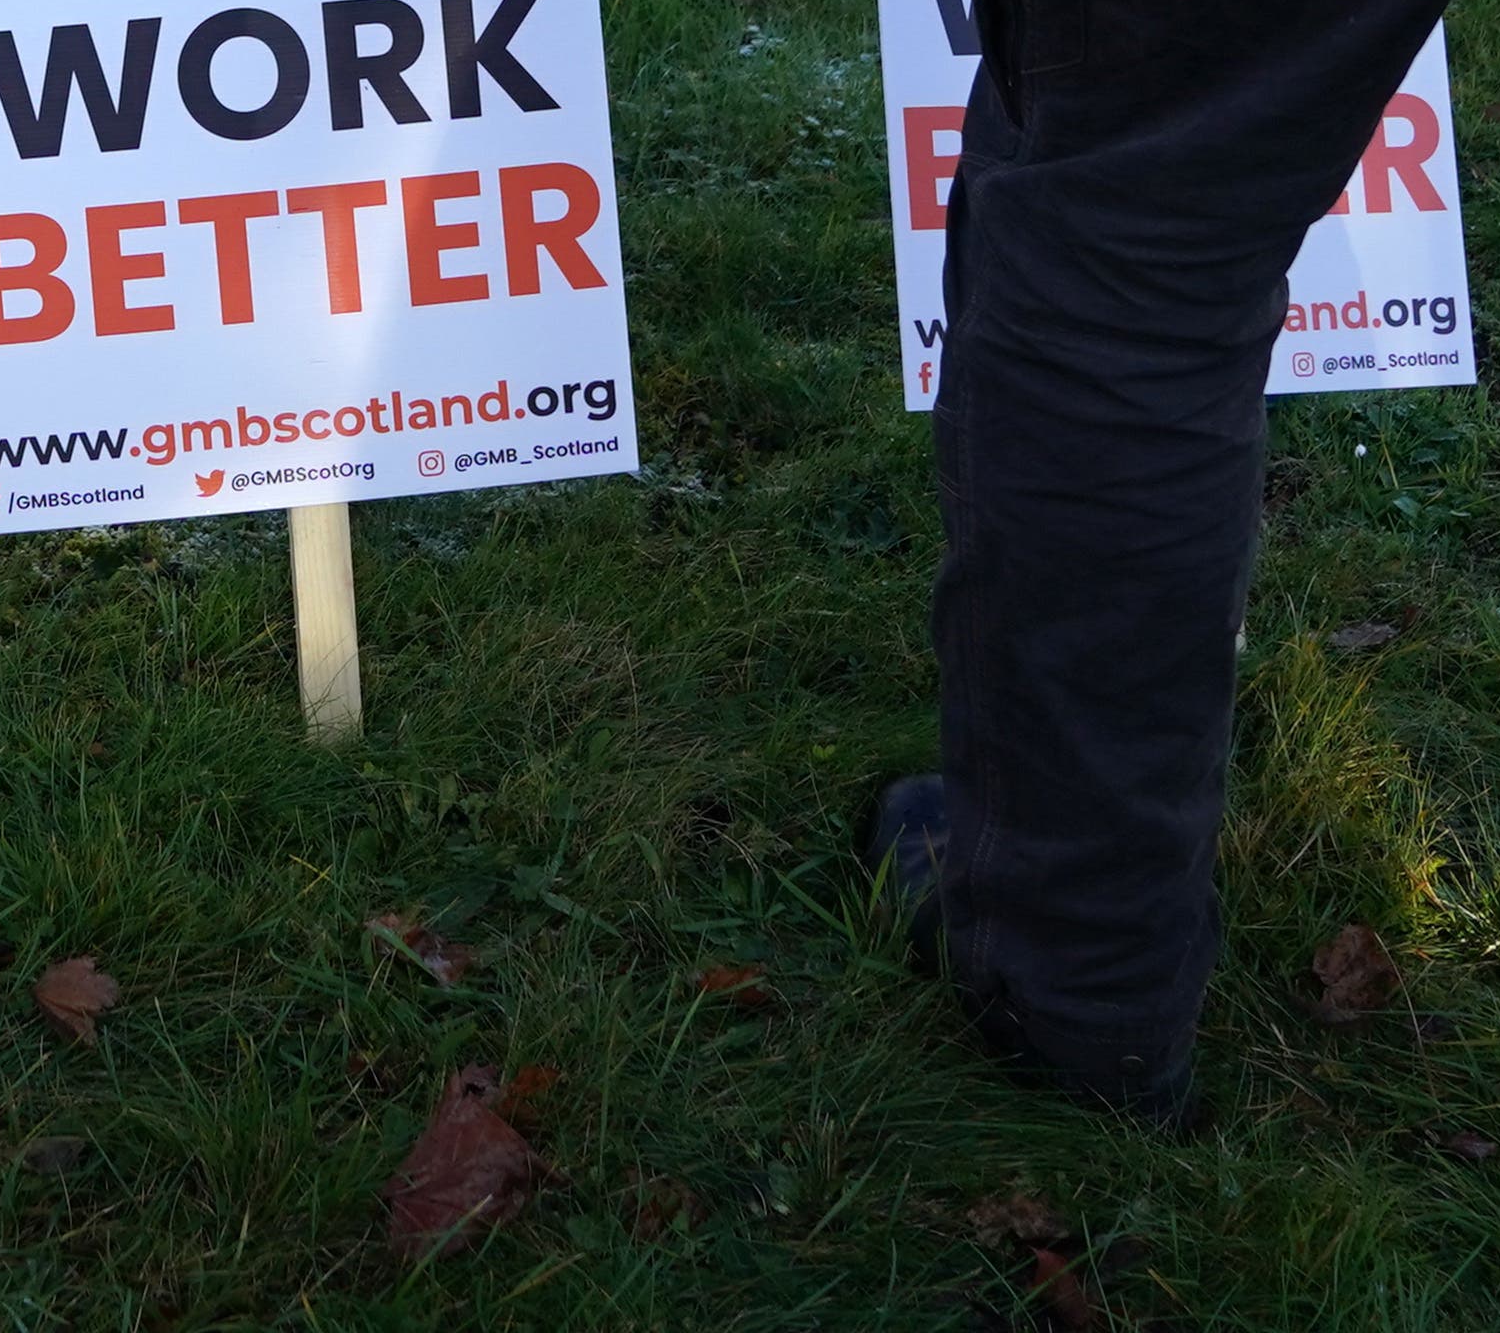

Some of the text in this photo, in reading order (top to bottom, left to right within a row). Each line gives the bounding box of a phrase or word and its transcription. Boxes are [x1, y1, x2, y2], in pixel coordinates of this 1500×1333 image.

[8, 485, 144, 514] /GMBScotland
[231, 459, 376, 492] @GMBScotOrg
[454, 436, 619, 473] @GMB_Scotland
